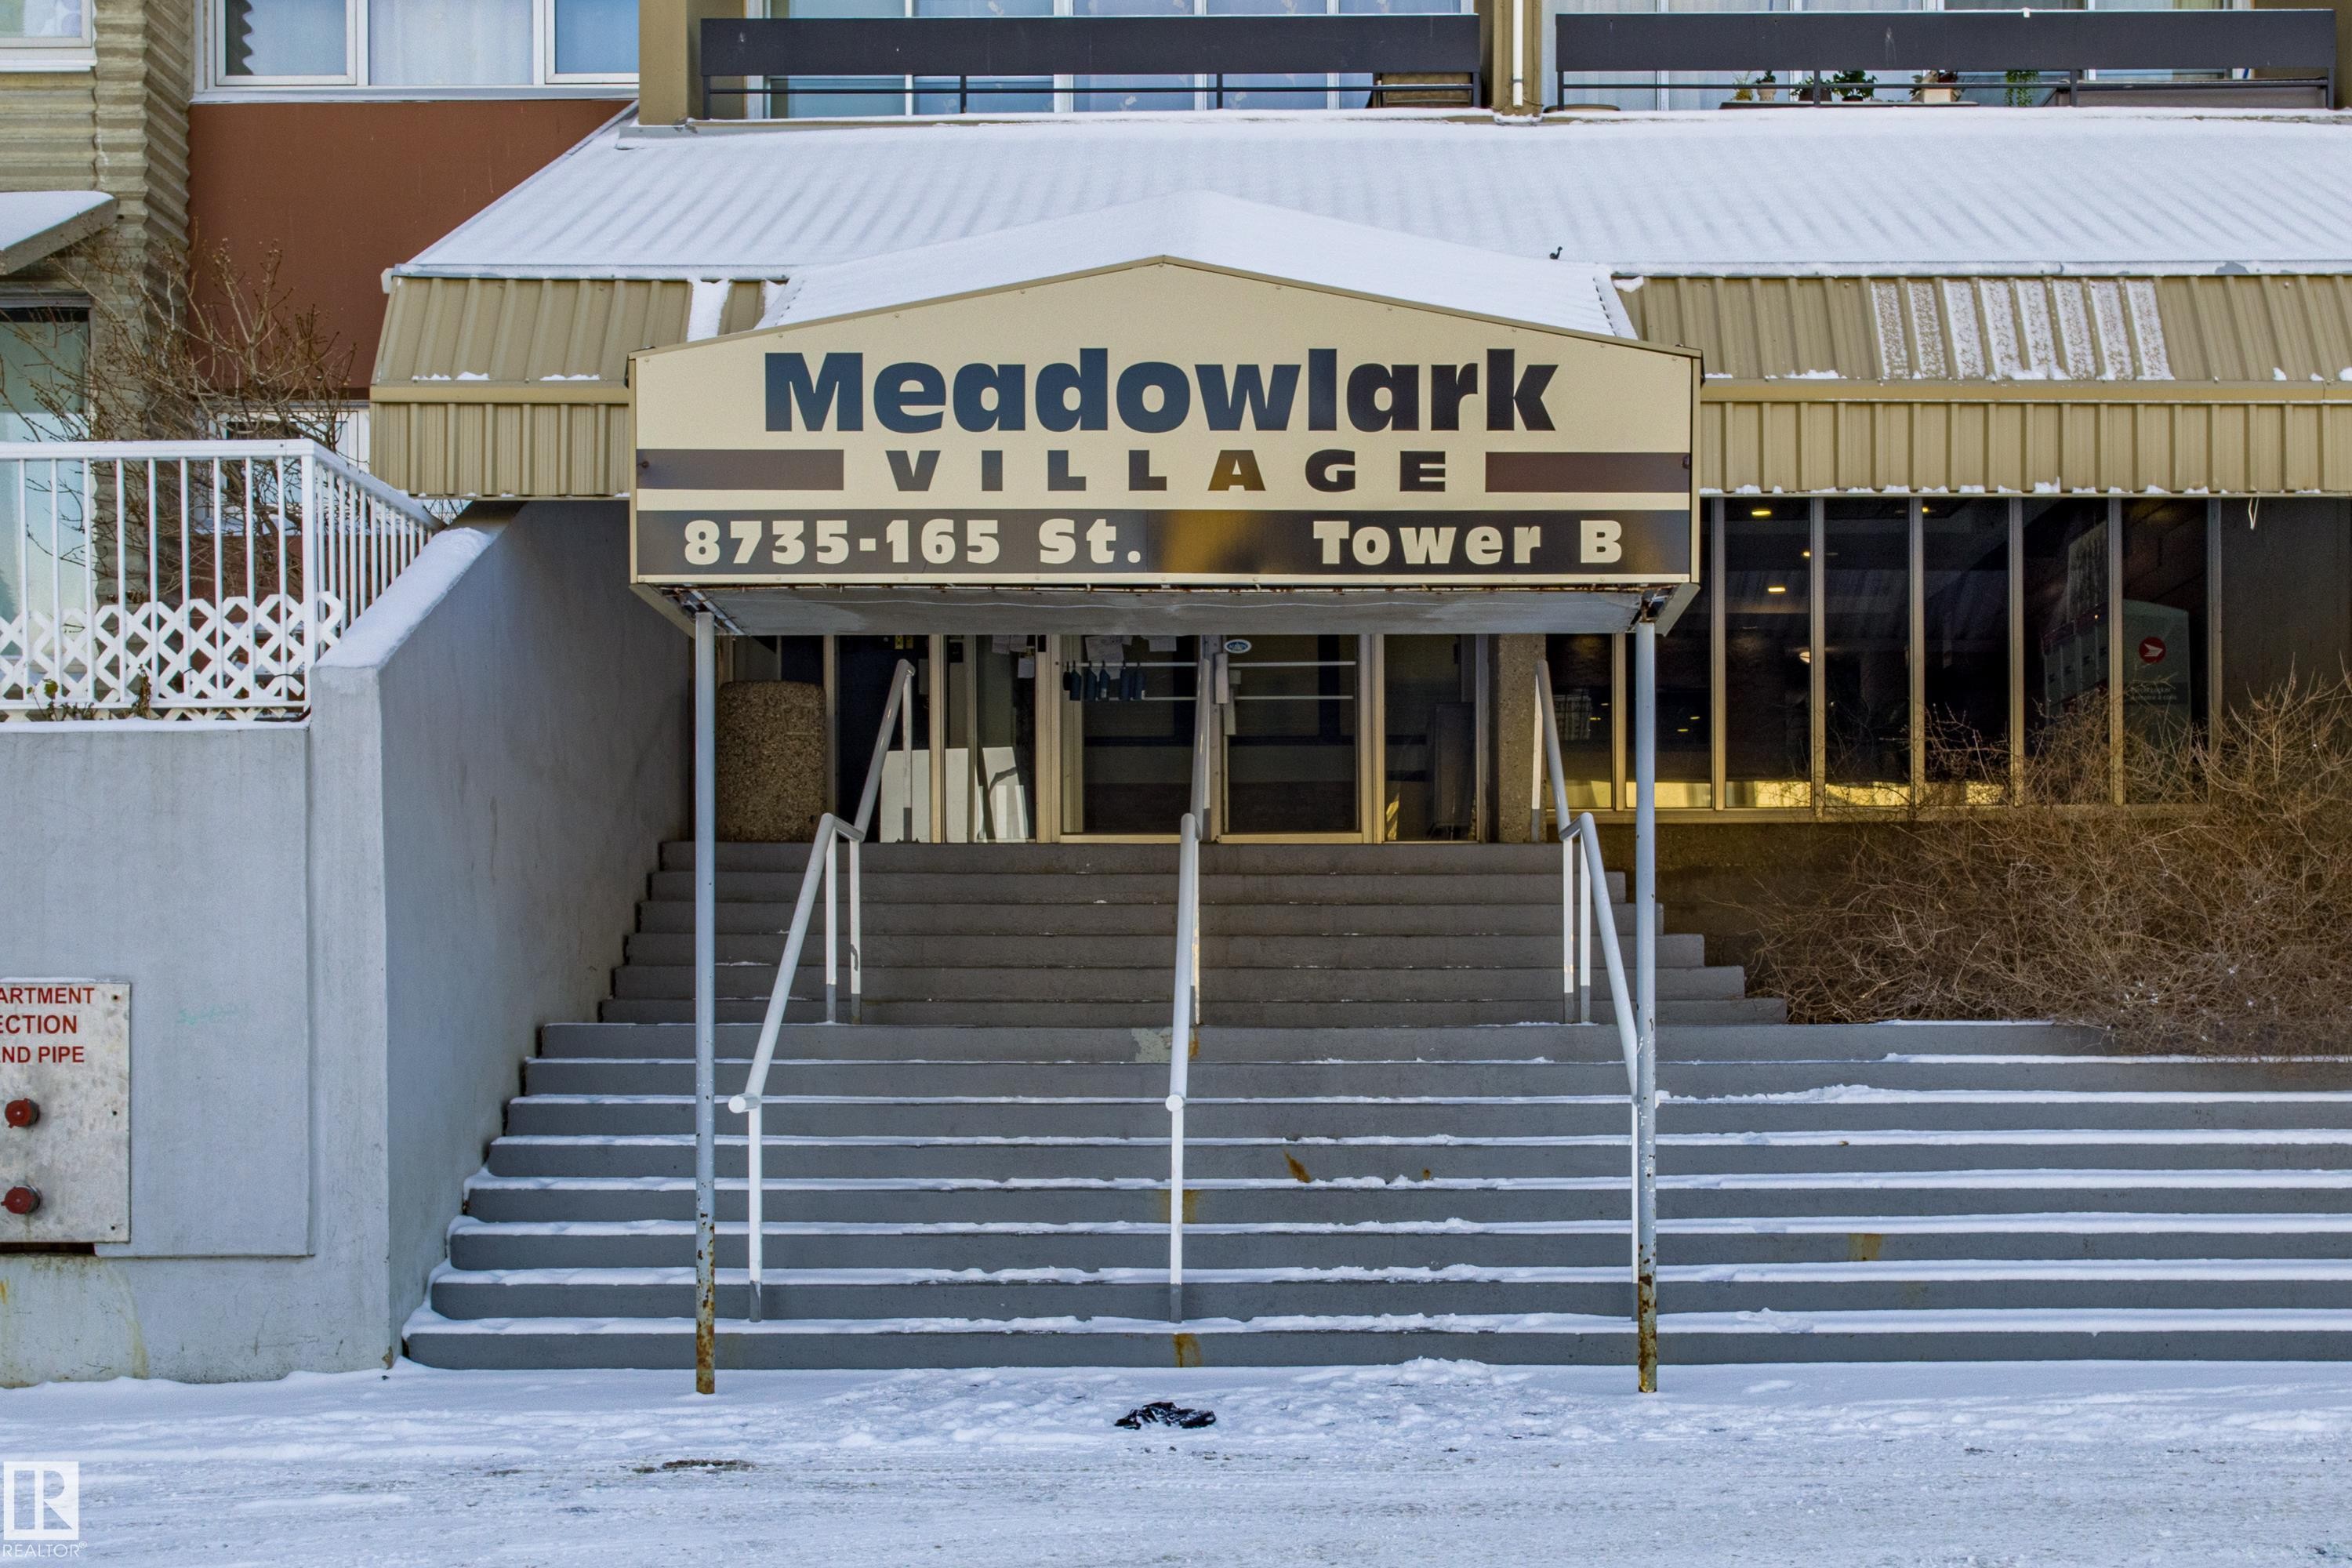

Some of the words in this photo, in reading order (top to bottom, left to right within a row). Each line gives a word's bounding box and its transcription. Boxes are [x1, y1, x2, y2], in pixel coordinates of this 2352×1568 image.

[765, 348, 1559, 434] Meadowlark
[886, 449, 1446, 492] VILLAGE
[685, 519, 1000, 564] 8735-165
[1039, 519, 1141, 564] St.
[1314, 521, 1541, 564] Tower
[1581, 521, 1622, 564] B
[38, 1046, 85, 1064] PIPE
